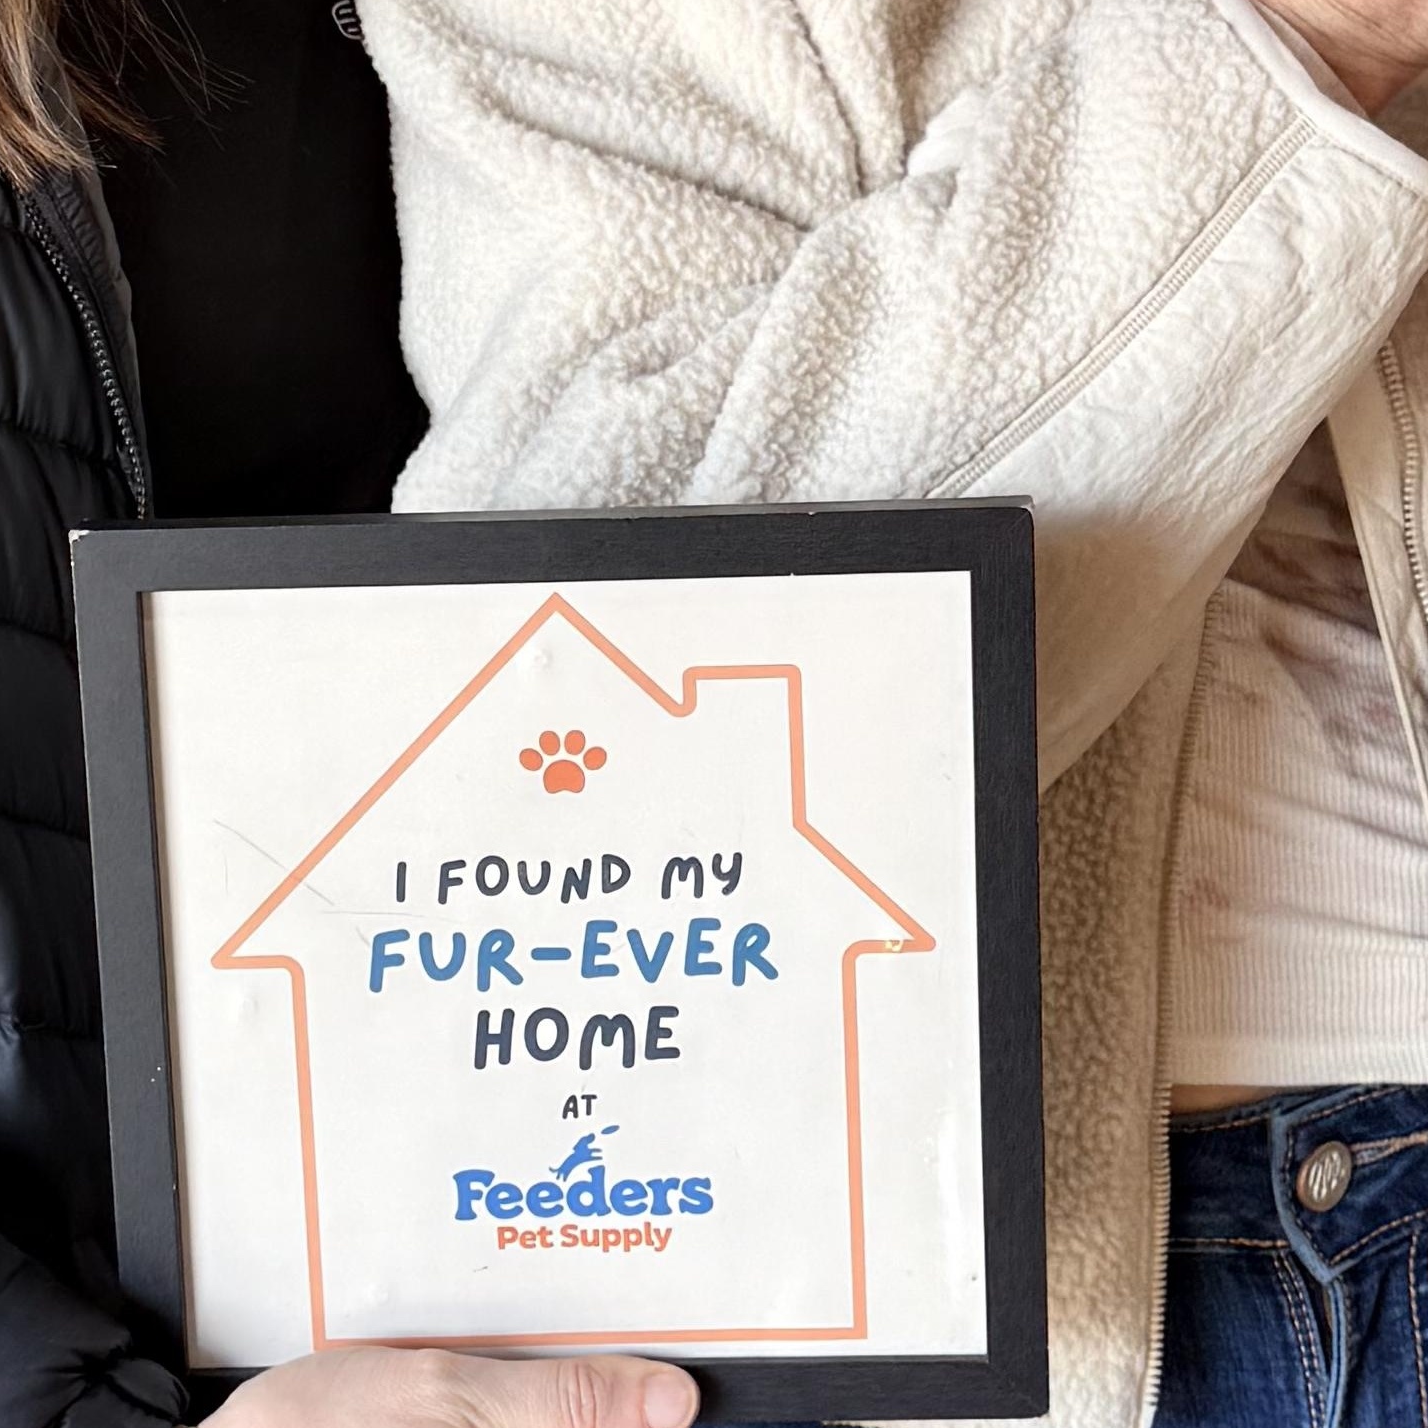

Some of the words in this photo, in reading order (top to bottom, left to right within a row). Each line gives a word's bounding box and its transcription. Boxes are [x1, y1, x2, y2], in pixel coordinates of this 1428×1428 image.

[395, 860, 408, 904] I
[437, 853, 632, 905] FOUND
[660, 850, 744, 900] MY
[368, 917, 780, 993] FUR-EVER
[473, 1005, 681, 1071] HOME
[561, 1093, 598, 1120] AT
[452, 1165, 714, 1221] Feeders
[496, 1225, 554, 1250] Pet
[560, 1221, 673, 1253] Supply
